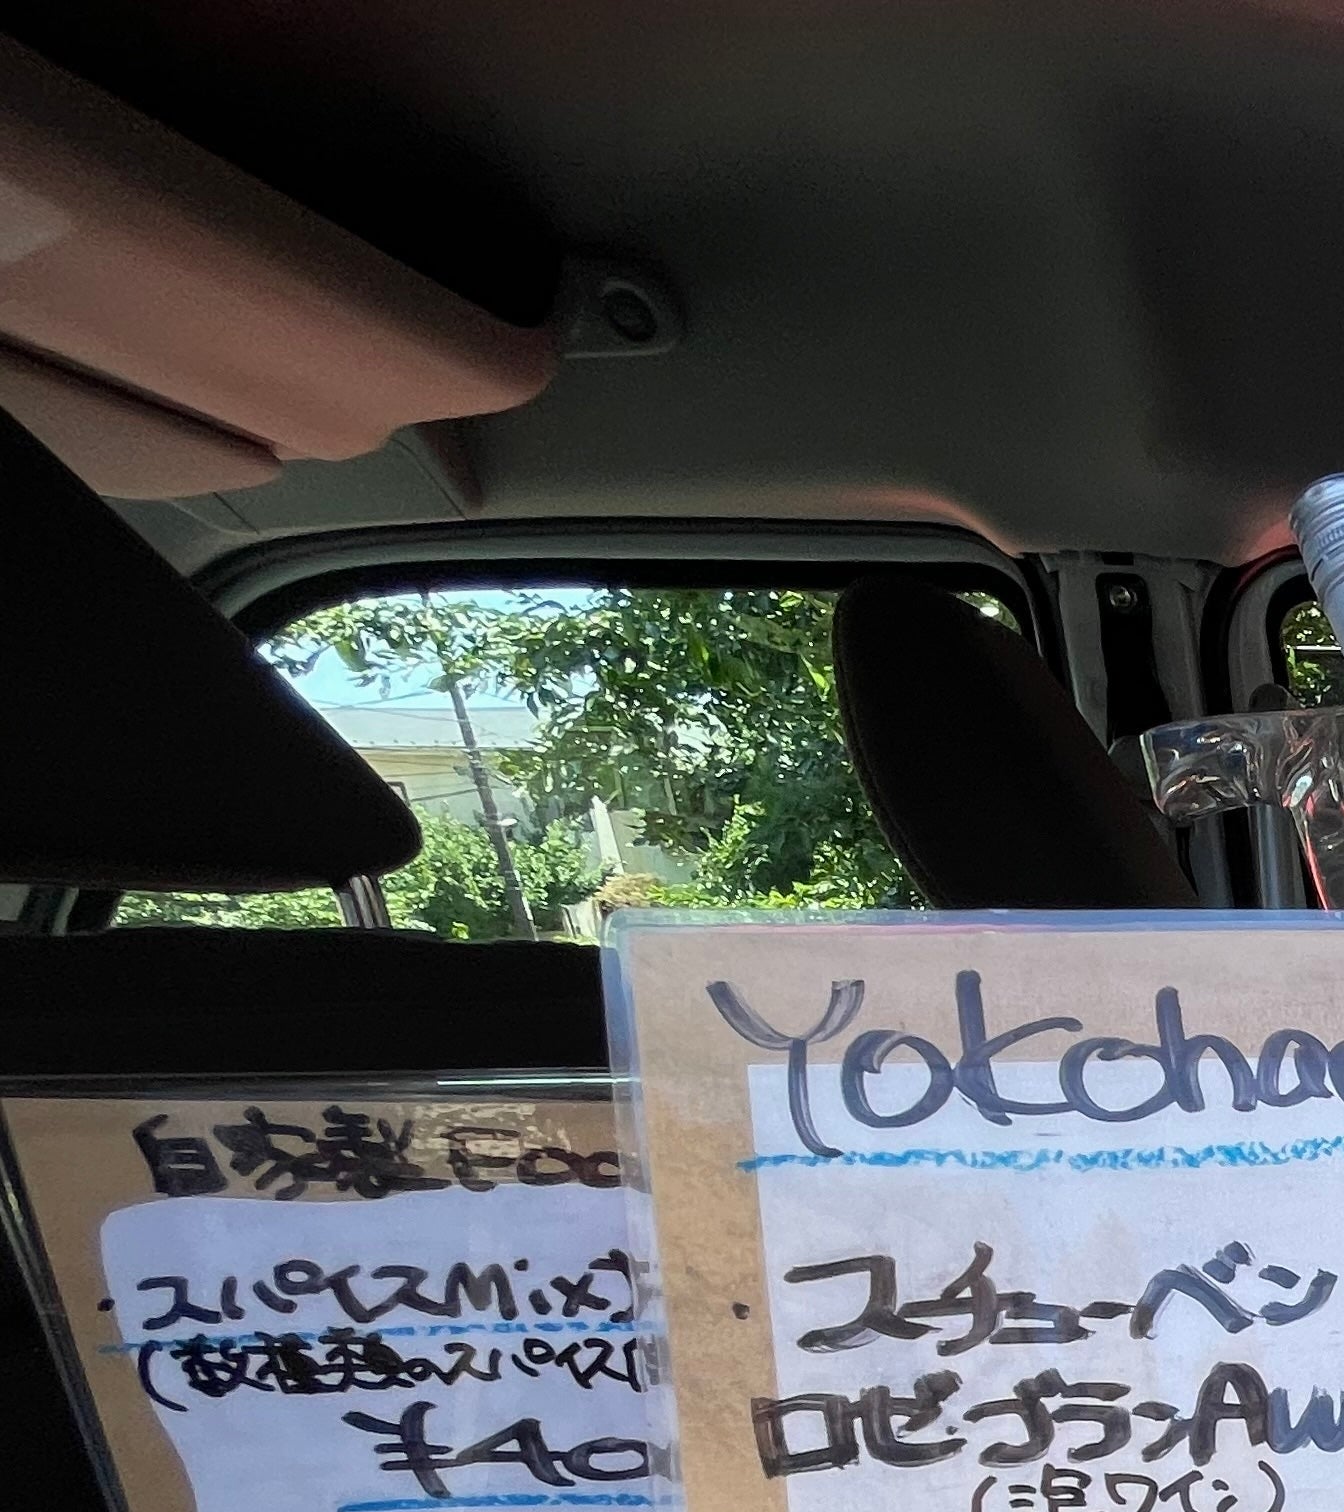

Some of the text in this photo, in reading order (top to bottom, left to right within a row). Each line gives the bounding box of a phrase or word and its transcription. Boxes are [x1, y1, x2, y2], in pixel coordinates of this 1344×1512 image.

[783, 1241, 1337, 1355] スチューベン
